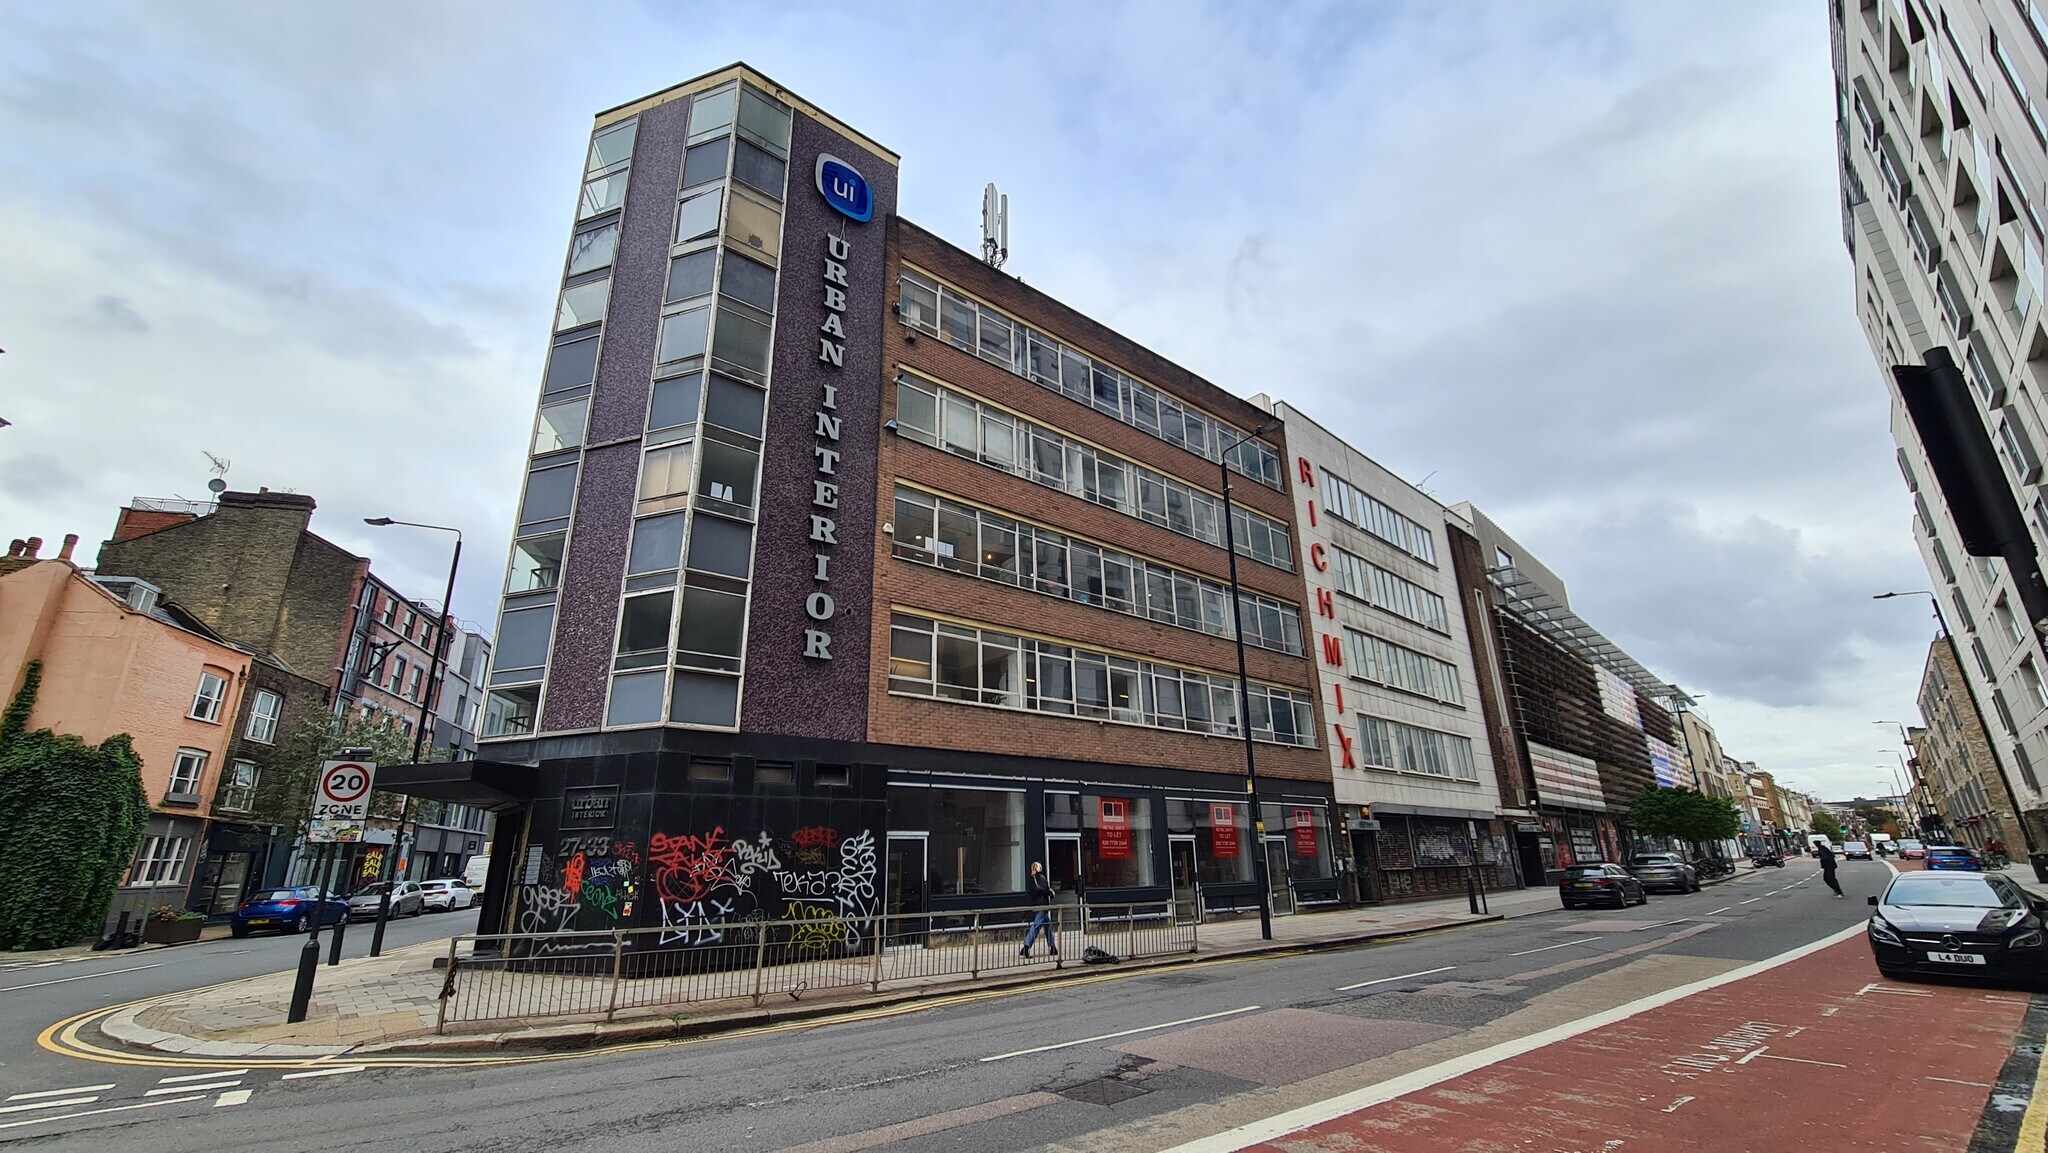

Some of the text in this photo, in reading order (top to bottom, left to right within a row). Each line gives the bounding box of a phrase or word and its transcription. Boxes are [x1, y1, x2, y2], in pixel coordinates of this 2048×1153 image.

[833, 176, 855, 203] ui
[803, 232, 851, 660] URBAN INTERIOR
[330, 774, 363, 791] 20
[318, 804, 363, 815] ZONE
[559, 836, 611, 857] 27-33
[366, 851, 383, 861] SALE
[364, 859, 382, 870] SALE
[362, 868, 381, 878] SALE
[1938, 953, 1974, 963] L4 DUO
